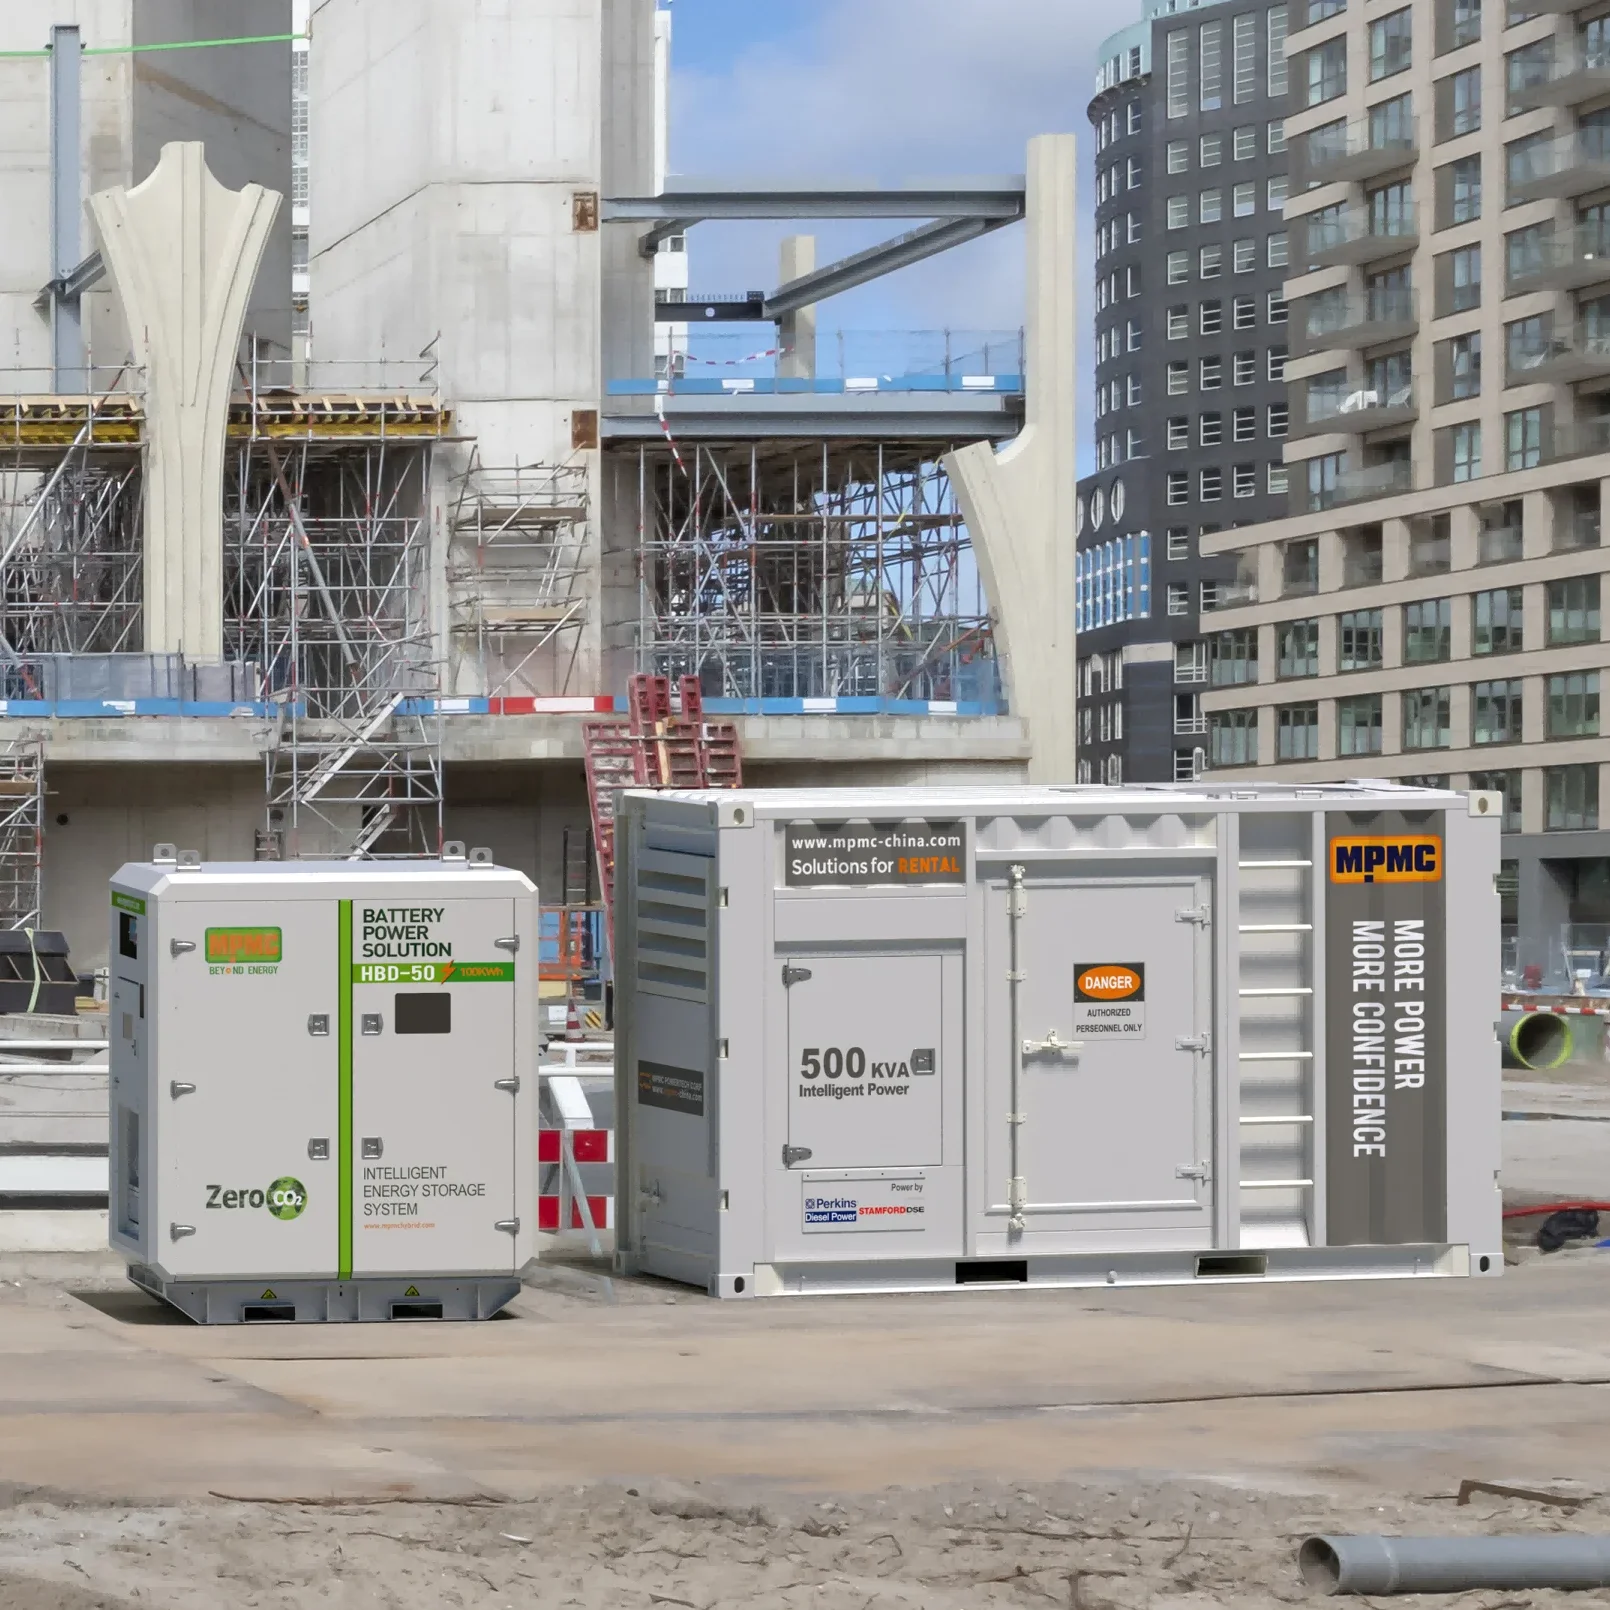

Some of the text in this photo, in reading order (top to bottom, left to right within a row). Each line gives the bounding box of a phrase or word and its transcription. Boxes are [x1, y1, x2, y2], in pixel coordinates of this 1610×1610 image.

[792, 833, 961, 852] www.mpmc-china.com
[792, 857, 960, 875] Solutions for RENTAL
[1336, 845, 1436, 883] MPMC
[363, 908, 445, 923] BATTERY
[363, 926, 429, 940] POWER
[209, 934, 279, 963] MPMC
[362, 942, 452, 957] SOLUTION
[248, 966, 278, 975] ENERGY
[361, 965, 435, 981] HBD-50
[1085, 976, 1133, 989] DANGER
[1087, 1008, 1131, 1017] AUTHORIZED
[1394, 920, 1425, 1090] MORE POWER
[1076, 1024, 1143, 1033] PERSEONNEL ONLY
[1352, 920, 1386, 1157] MORE CONFIDENCE
[800, 1047, 910, 1079] 500 KVA
[799, 1083, 910, 1100] Intelligent Power
[363, 1166, 447, 1180] INTELLIGENT
[363, 1183, 486, 1198] ENERGY STORAGE
[891, 1183, 924, 1193] Power by
[205, 1184, 265, 1209] Zero
[816, 1198, 857, 1209] Perkins
[363, 1202, 418, 1216] SYSTEM
[805, 1212, 857, 1223] Diesel Power
